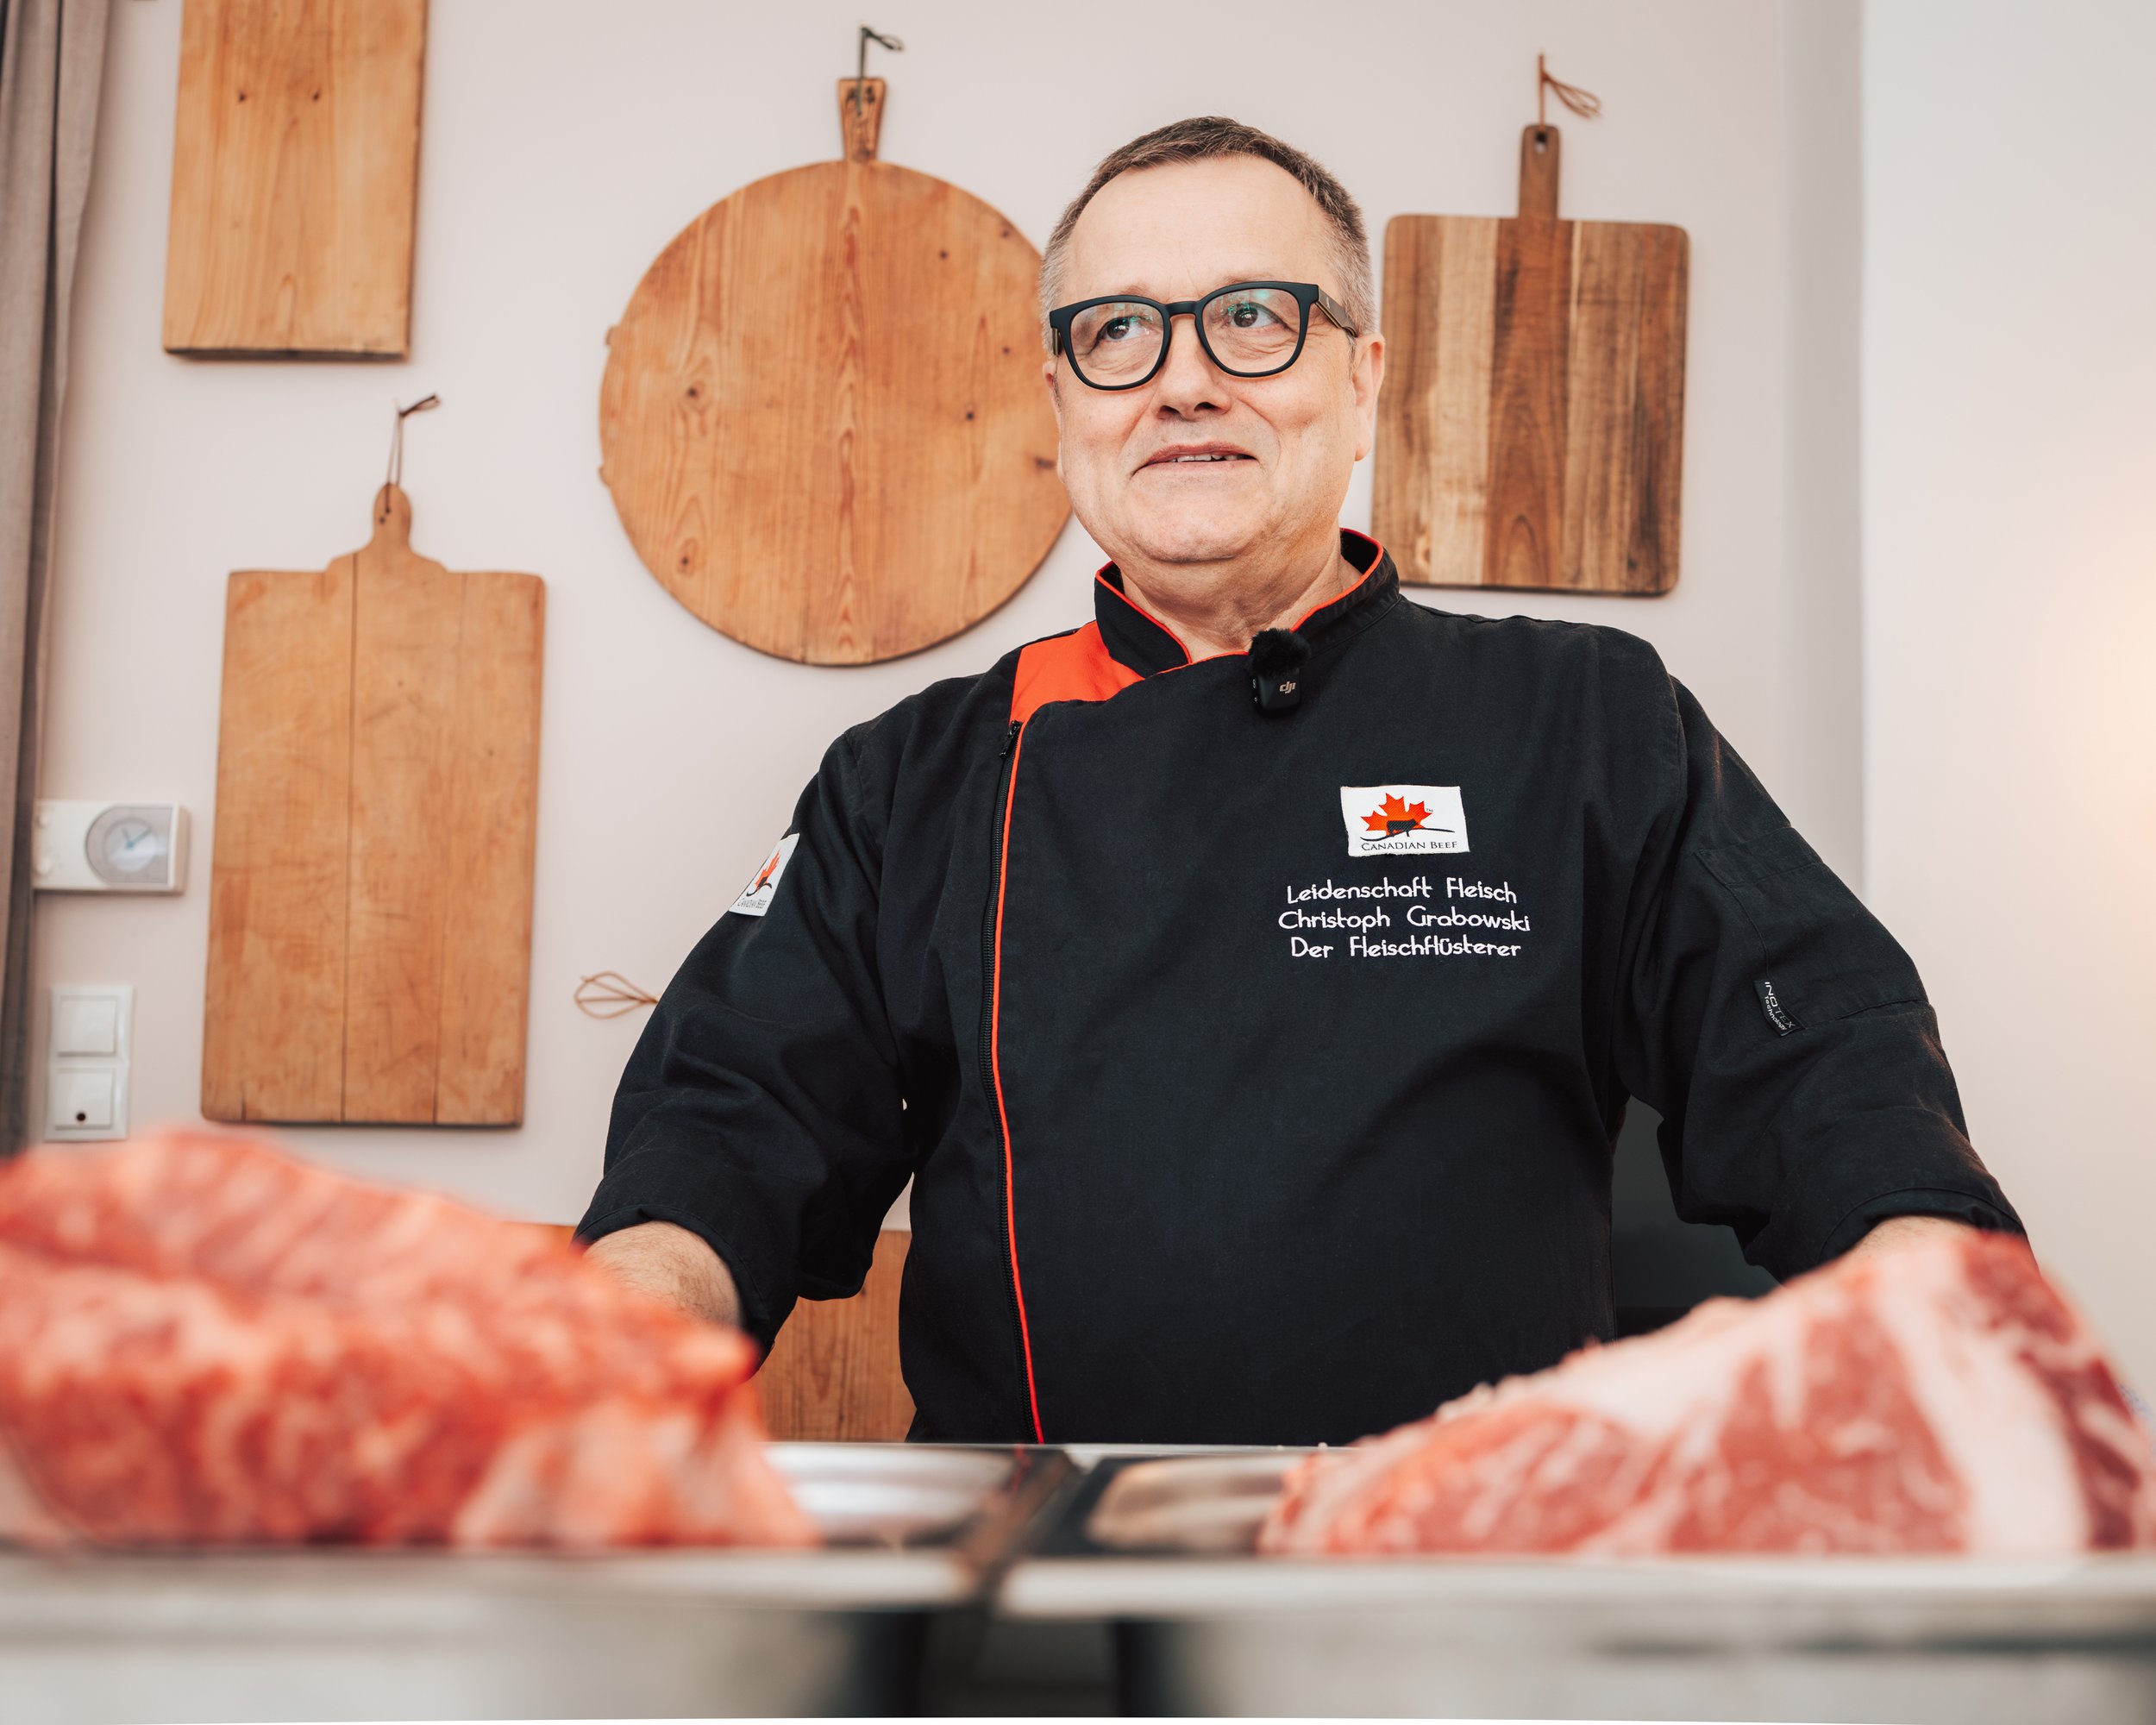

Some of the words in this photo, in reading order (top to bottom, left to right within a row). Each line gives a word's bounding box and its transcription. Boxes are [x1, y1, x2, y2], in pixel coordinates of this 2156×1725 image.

[1361, 842, 1426, 851] CANADIAN
[1430, 841, 1457, 850] BEEF
[1288, 876, 1432, 904] Leidenschaft
[1446, 877, 1517, 904] Fleisch
[1278, 906, 1391, 933] Christoph
[1407, 905, 1531, 932] Grabowski
[1291, 936, 1334, 958] Der
[1350, 934, 1521, 957] Fleischflüsterer
